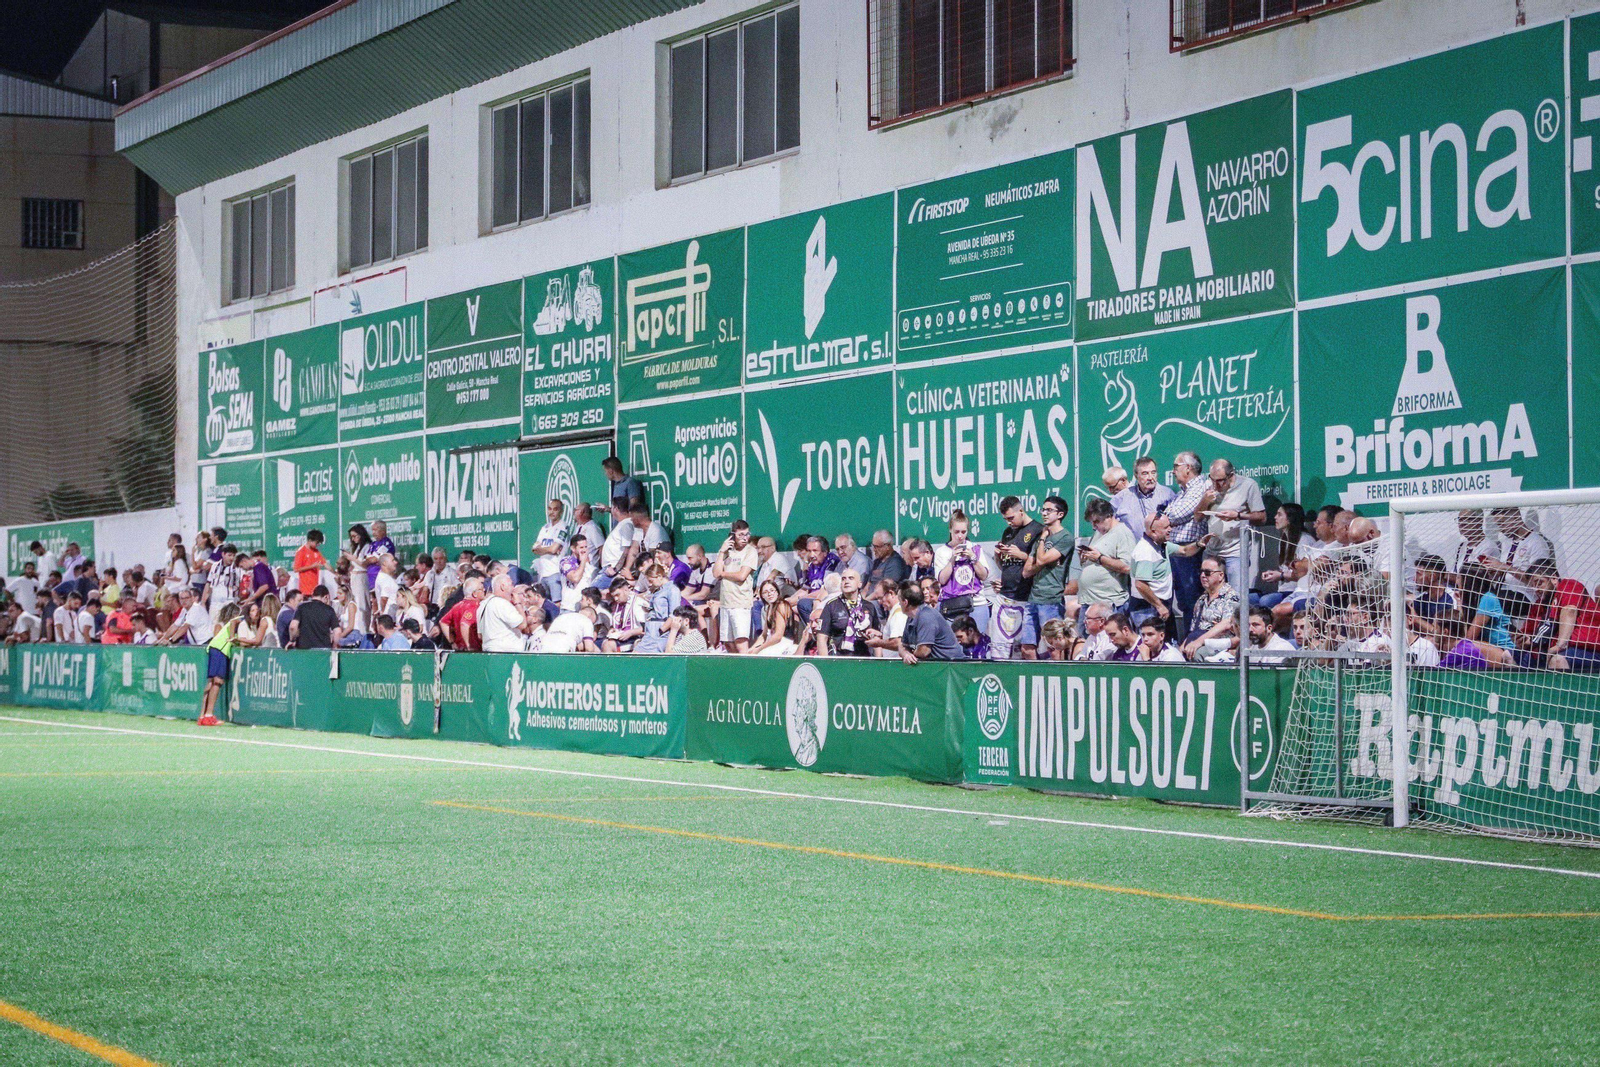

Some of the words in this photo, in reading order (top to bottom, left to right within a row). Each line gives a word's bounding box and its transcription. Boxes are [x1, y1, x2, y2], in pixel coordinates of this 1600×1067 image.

[1206, 146, 1289, 192] NAVARRO
[925, 197, 970, 221] FIRSTSTOP
[985, 183, 1033, 208] NEUMÁTICOS
[1034, 178, 1060, 196] ZAFRA
[1206, 180, 1270, 225] AZORÍN
[1076, 119, 1214, 300] NA
[947, 238, 972, 254] AVENIDA
[972, 237, 980, 249] DE
[980, 230, 999, 247] ÚBEDA
[949, 254, 968, 265] MANCHA
[968, 251, 979, 262] REAL
[969, 293, 992, 303] SERVICIOS
[1087, 290, 1156, 321] TIRADORES
[1159, 284, 1193, 309] PARA
[1196, 268, 1275, 302] MOBILIARIO
[1154, 310, 1173, 326] MADE
[1173, 309, 1181, 323] IN
[1181, 305, 1201, 321] SPAIN
[364, 315, 422, 372] OLIDUL
[525, 344, 545, 371] EL
[551, 333, 611, 369] CHURRI
[1090, 344, 1149, 370] PASTELERÍA
[208, 352, 240, 396] Bolsas
[427, 357, 458, 379] CENTRO
[459, 351, 489, 374] DENTAL
[489, 346, 521, 369] VALERO
[534, 369, 591, 389] EXCAVACIONES
[594, 367, 600, 381] Y
[671, 360, 681, 374] DE
[681, 355, 718, 372] MOLDURAS
[1159, 349, 1258, 404] PLANET
[227, 391, 253, 429] SEMA
[524, 390, 564, 407] SERVICIOS
[566, 383, 611, 403] AGRÍCOLAS
[906, 382, 964, 415] CLÍNICA
[968, 374, 1061, 408] VETERINARIA
[1196, 385, 1285, 425] CAFETERÍA
[1397, 391, 1456, 413] BRIFORMA
[265, 418, 297, 433] GAMEZ
[538, 414, 558, 430] 663
[560, 411, 580, 428] 309
[582, 408, 604, 425] 250
[674, 416, 738, 447] Agroservicios
[801, 434, 891, 491] TORGA
[903, 404, 1069, 490] HUELLAS
[297, 462, 333, 494] Lacrist
[362, 457, 387, 487] cobo
[388, 452, 421, 491] pulido
[1366, 478, 1419, 500] FERRETERIA
[1422, 481, 1430, 495] &
[1431, 474, 1491, 495] BRICOLAGE
[909, 496, 924, 522] C/
[927, 494, 966, 523] Virgen
[968, 492, 988, 516] del
[992, 488, 1041, 515] Rrio,
[345, 681, 397, 700] AYUNTAMIENTO
[417, 683, 450, 702] MANHA
[451, 684, 474, 703] REAL
[526, 681, 603, 711] MORTEROS
[605, 684, 625, 712] EL
[627, 678, 669, 714] LEÓN
[526, 709, 566, 730] Adhesivos
[568, 714, 619, 733] cementosos
[620, 721, 627, 738] y
[629, 718, 668, 736] morteros
[706, 698, 782, 726] AGRÍCOLA
[832, 703, 923, 735] COLVMELA
[1018, 675, 1216, 791] IMPULSO27
[978, 746, 1009, 767] TERCERA
[978, 767, 1010, 777] FEDERACIÓN
